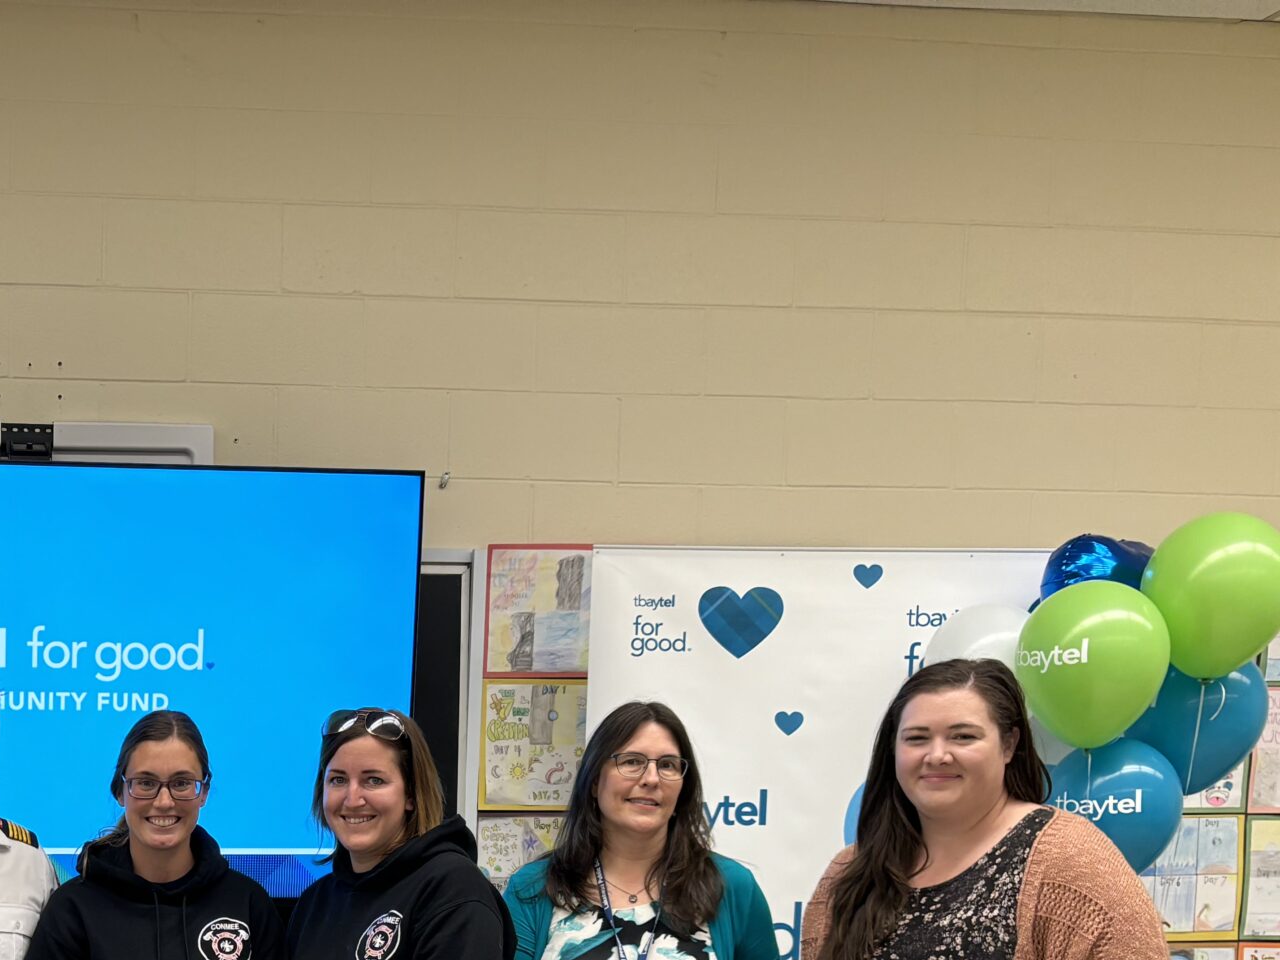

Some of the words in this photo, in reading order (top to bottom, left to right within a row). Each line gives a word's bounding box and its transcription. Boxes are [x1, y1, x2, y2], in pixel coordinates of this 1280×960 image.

[633, 594, 676, 611] tbaytel
[632, 614, 664, 636] for
[25, 625, 88, 669] for
[96, 691, 170, 712] FUND
[1055, 788, 1142, 821] tbaytel
[210, 922, 240, 931] CONMEE
